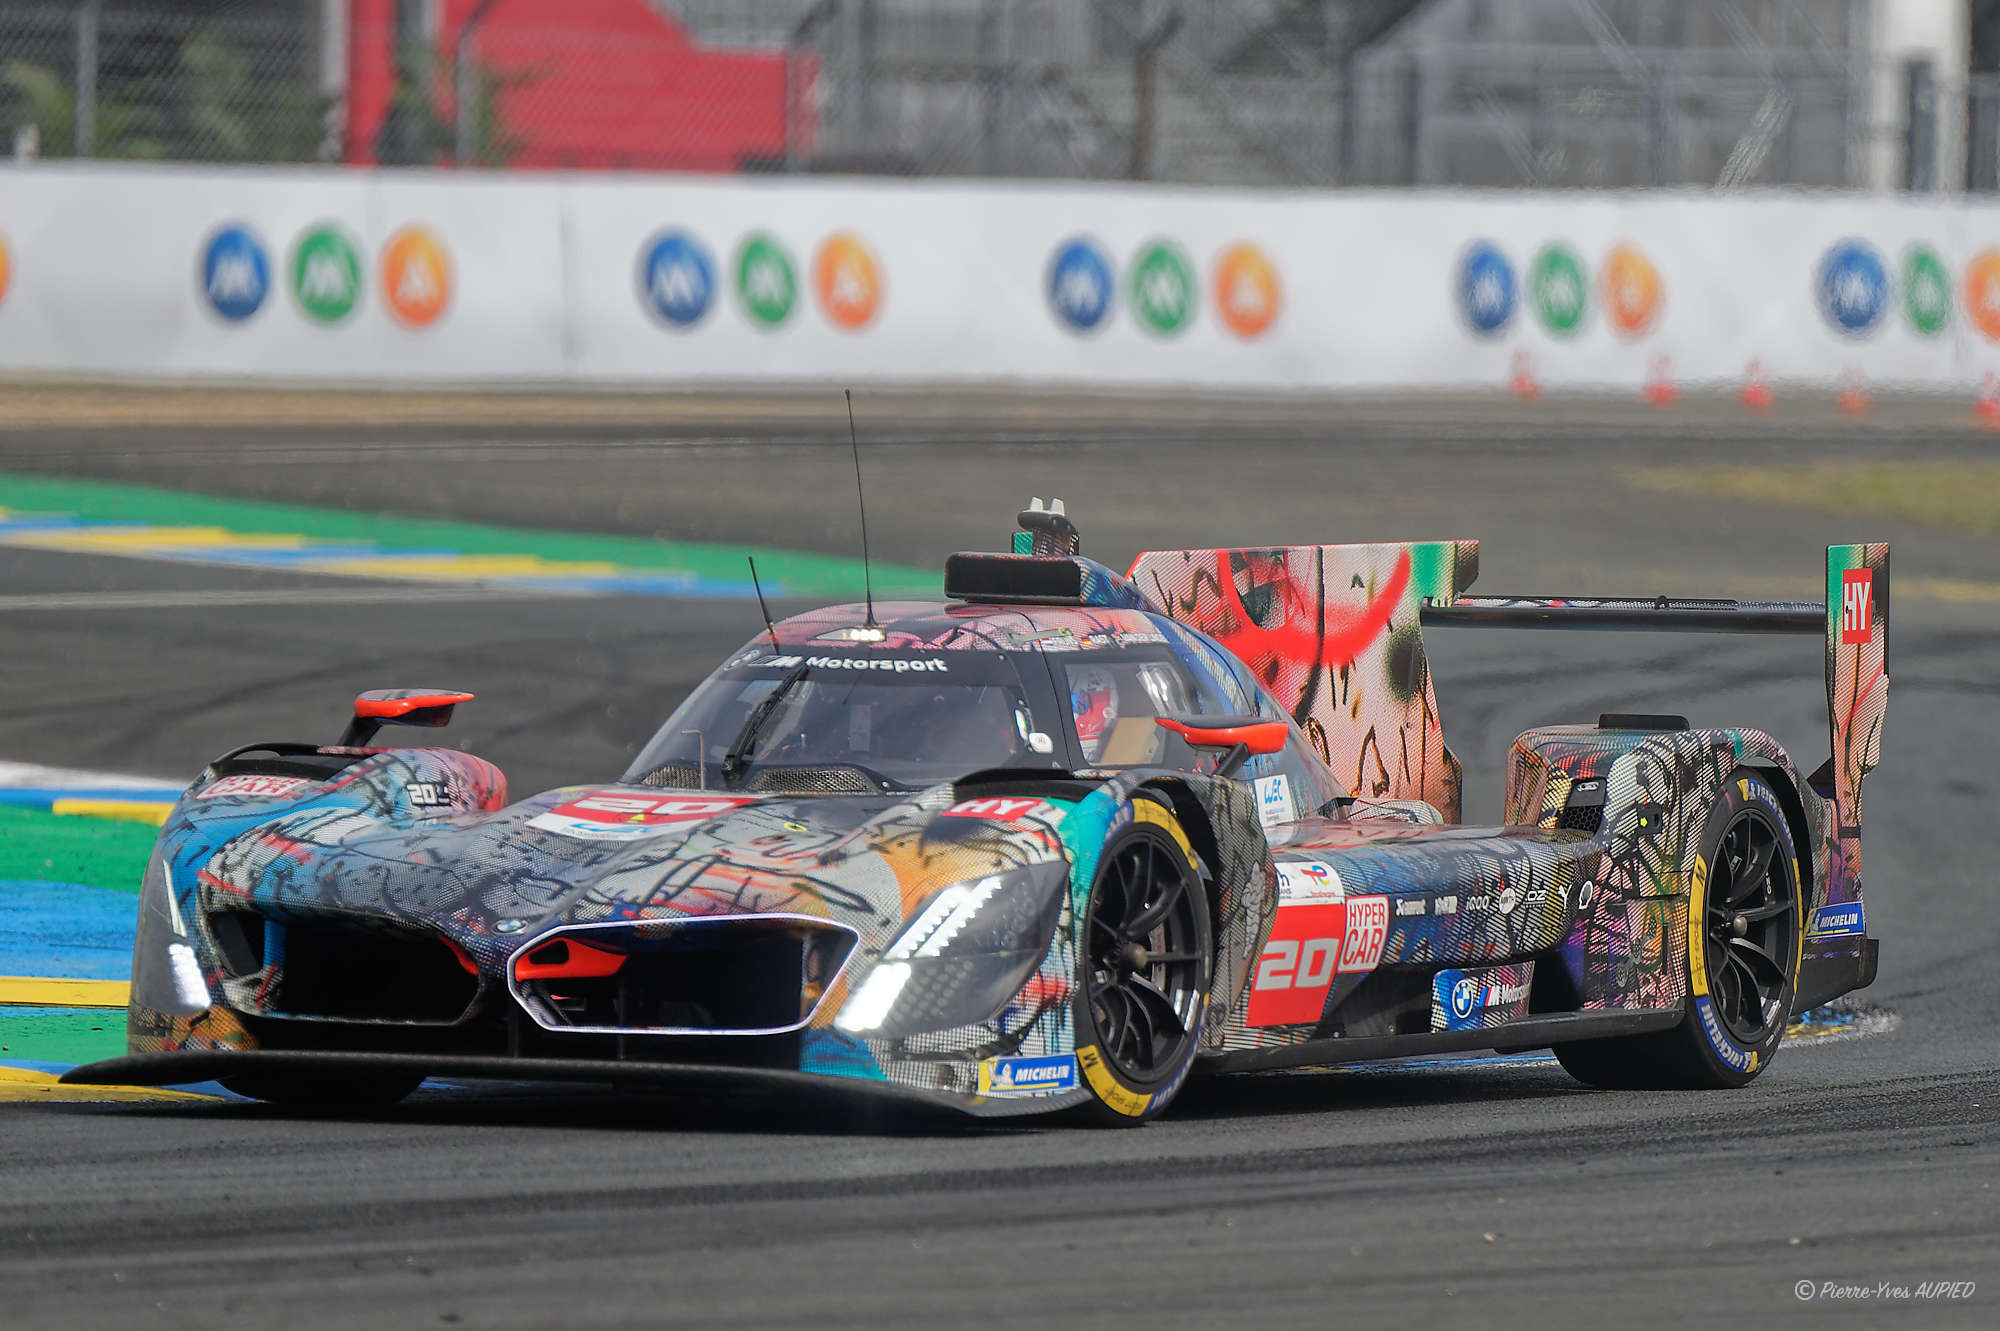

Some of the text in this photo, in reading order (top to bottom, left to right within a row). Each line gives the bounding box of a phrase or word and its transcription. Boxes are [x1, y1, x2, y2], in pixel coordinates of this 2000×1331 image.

[1844, 582, 1870, 631] HY
[806, 656, 949, 673] Motorsport
[205, 782, 288, 795] CAR
[1264, 778, 1284, 804] WEC
[573, 796, 736, 814] 20
[950, 799, 1034, 815] HY
[1349, 902, 1386, 928] HYPER
[1820, 912, 1858, 928] MICHELIN
[1342, 927, 1384, 966] CAR
[1254, 937, 1340, 992] 20
[1015, 1065, 1071, 1082] MICHELIN
